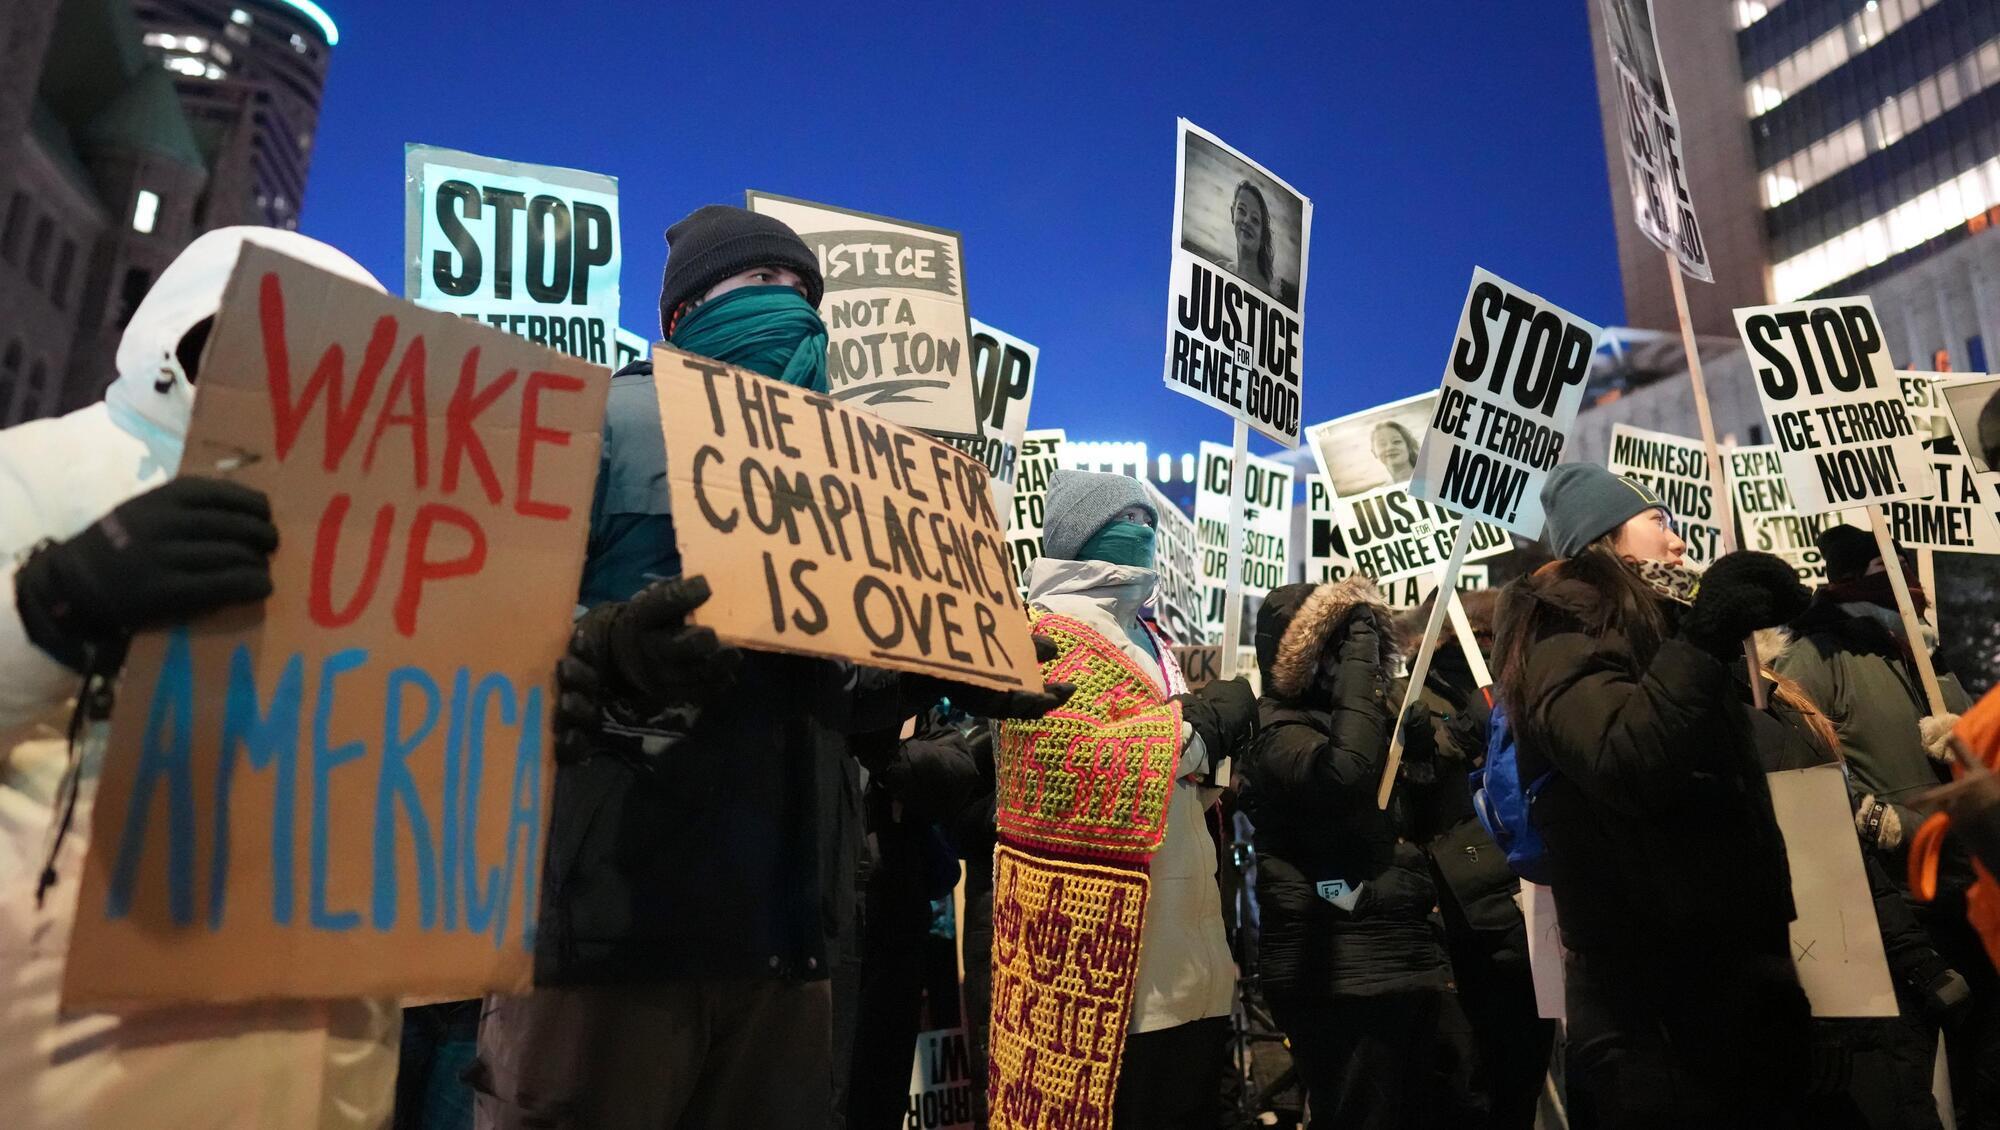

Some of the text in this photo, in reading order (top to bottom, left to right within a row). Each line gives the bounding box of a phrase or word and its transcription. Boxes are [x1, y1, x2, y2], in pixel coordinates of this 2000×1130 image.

[433, 179, 613, 306] STOP
[827, 331, 961, 386] MOTION
[832, 298, 915, 329] NOT A
[1178, 262, 1299, 386] JUSTICE
[1237, 346, 1251, 367] FOR
[1453, 282, 1593, 418] STOP
[1745, 304, 1881, 401] STOP
[260, 272, 586, 521] WAKE
[973, 333, 1032, 430] OP
[1171, 329, 1299, 437] RENEE GOOD
[1433, 386, 1565, 473] ICE TERROR
[1772, 411, 1821, 453] ICE
[1817, 399, 1914, 446] TERROR
[683, 359, 1000, 532] THE TIME FOR
[1244, 464, 1289, 511] OUT
[1439, 445, 1530, 524] NOW!
[1815, 445, 1907, 504] NOW!
[309, 494, 487, 637] UP
[692, 445, 1019, 611] COMPLACENCY
[1197, 516, 1285, 563] MINSOTA
[1355, 537, 1436, 582] RENEE
[1415, 526, 1431, 536] FOR
[763, 551, 829, 635] IS
[853, 574, 1014, 669] OVER
[105, 622, 544, 952] AMERICA
